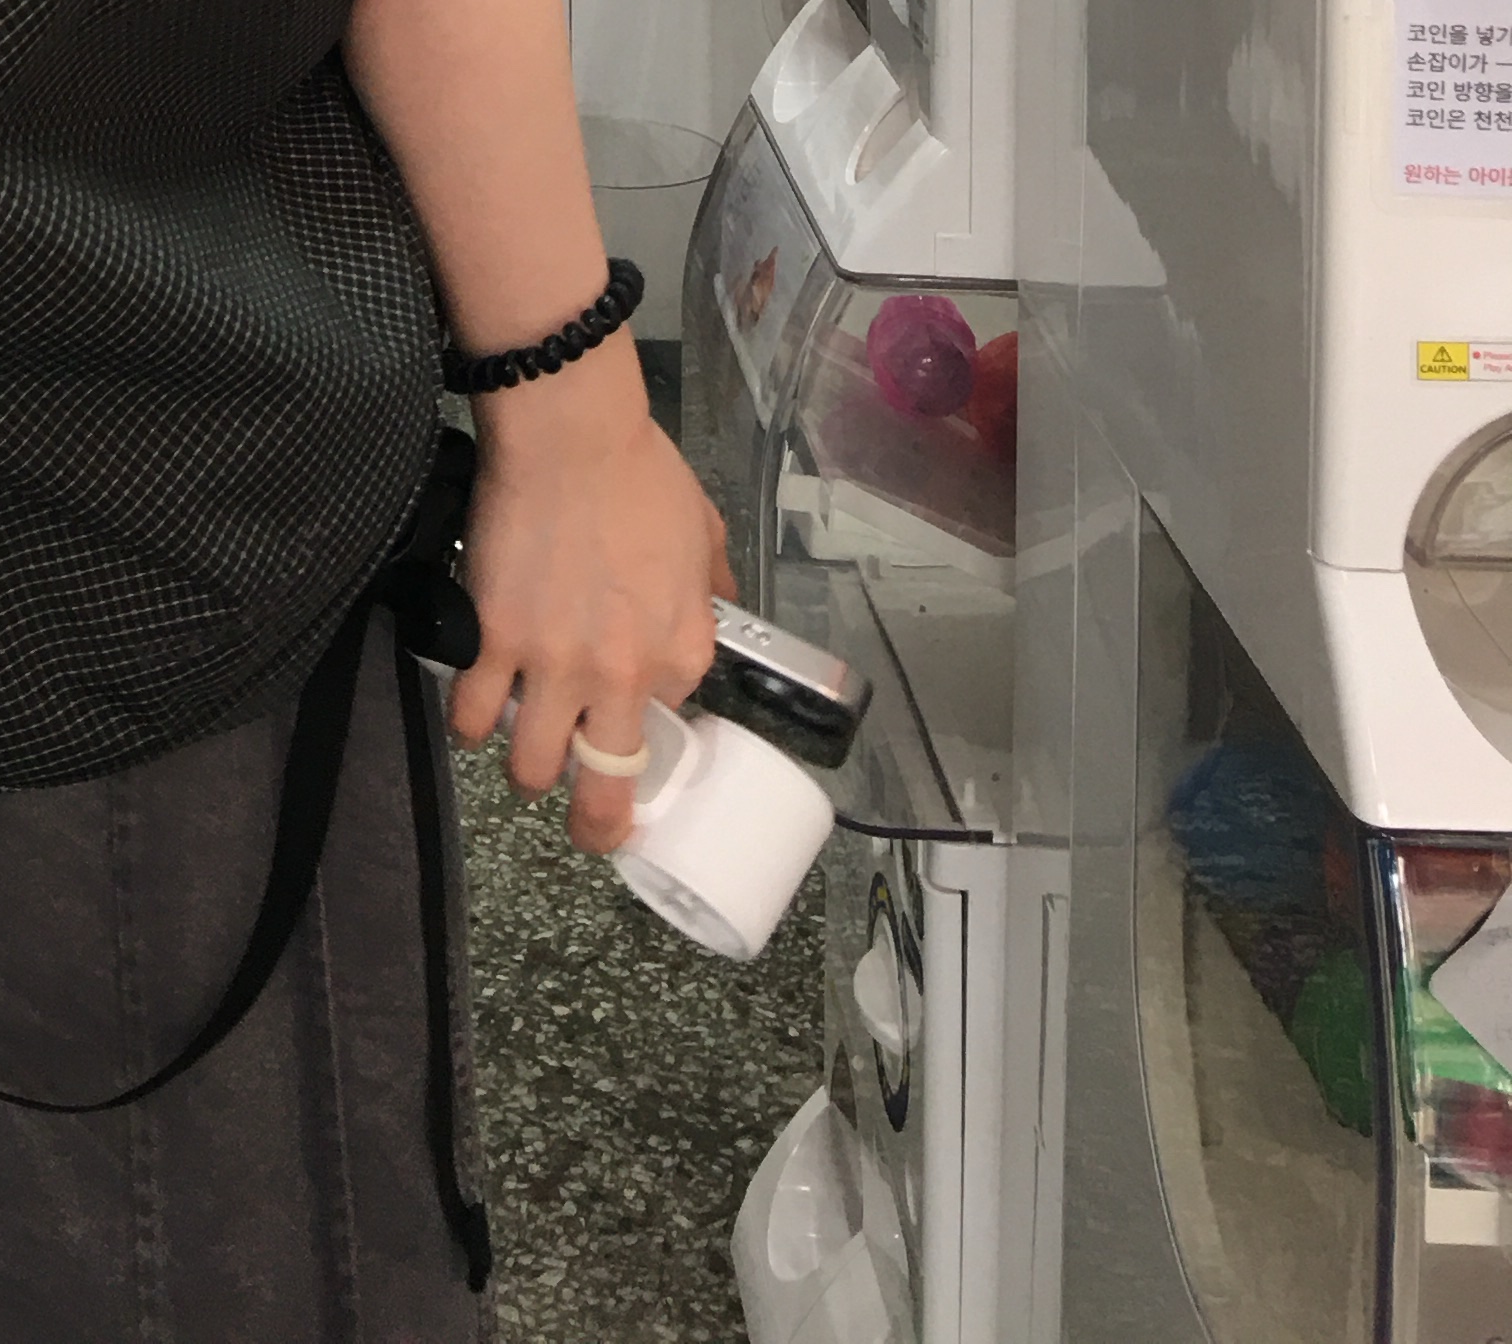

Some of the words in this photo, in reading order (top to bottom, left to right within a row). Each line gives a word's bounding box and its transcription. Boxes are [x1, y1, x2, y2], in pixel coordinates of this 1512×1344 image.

[1407, 24, 1468, 46] 코인을
[1407, 52, 1488, 74] 손잡이가
[1406, 80, 1445, 101] 코인
[1454, 81, 1512, 104] 방향을
[1405, 108, 1466, 131] 코인은
[1473, 111, 1512, 132] 천천
[1404, 163, 1462, 186] 원하는
[1420, 364, 1467, 375] CAUTION
